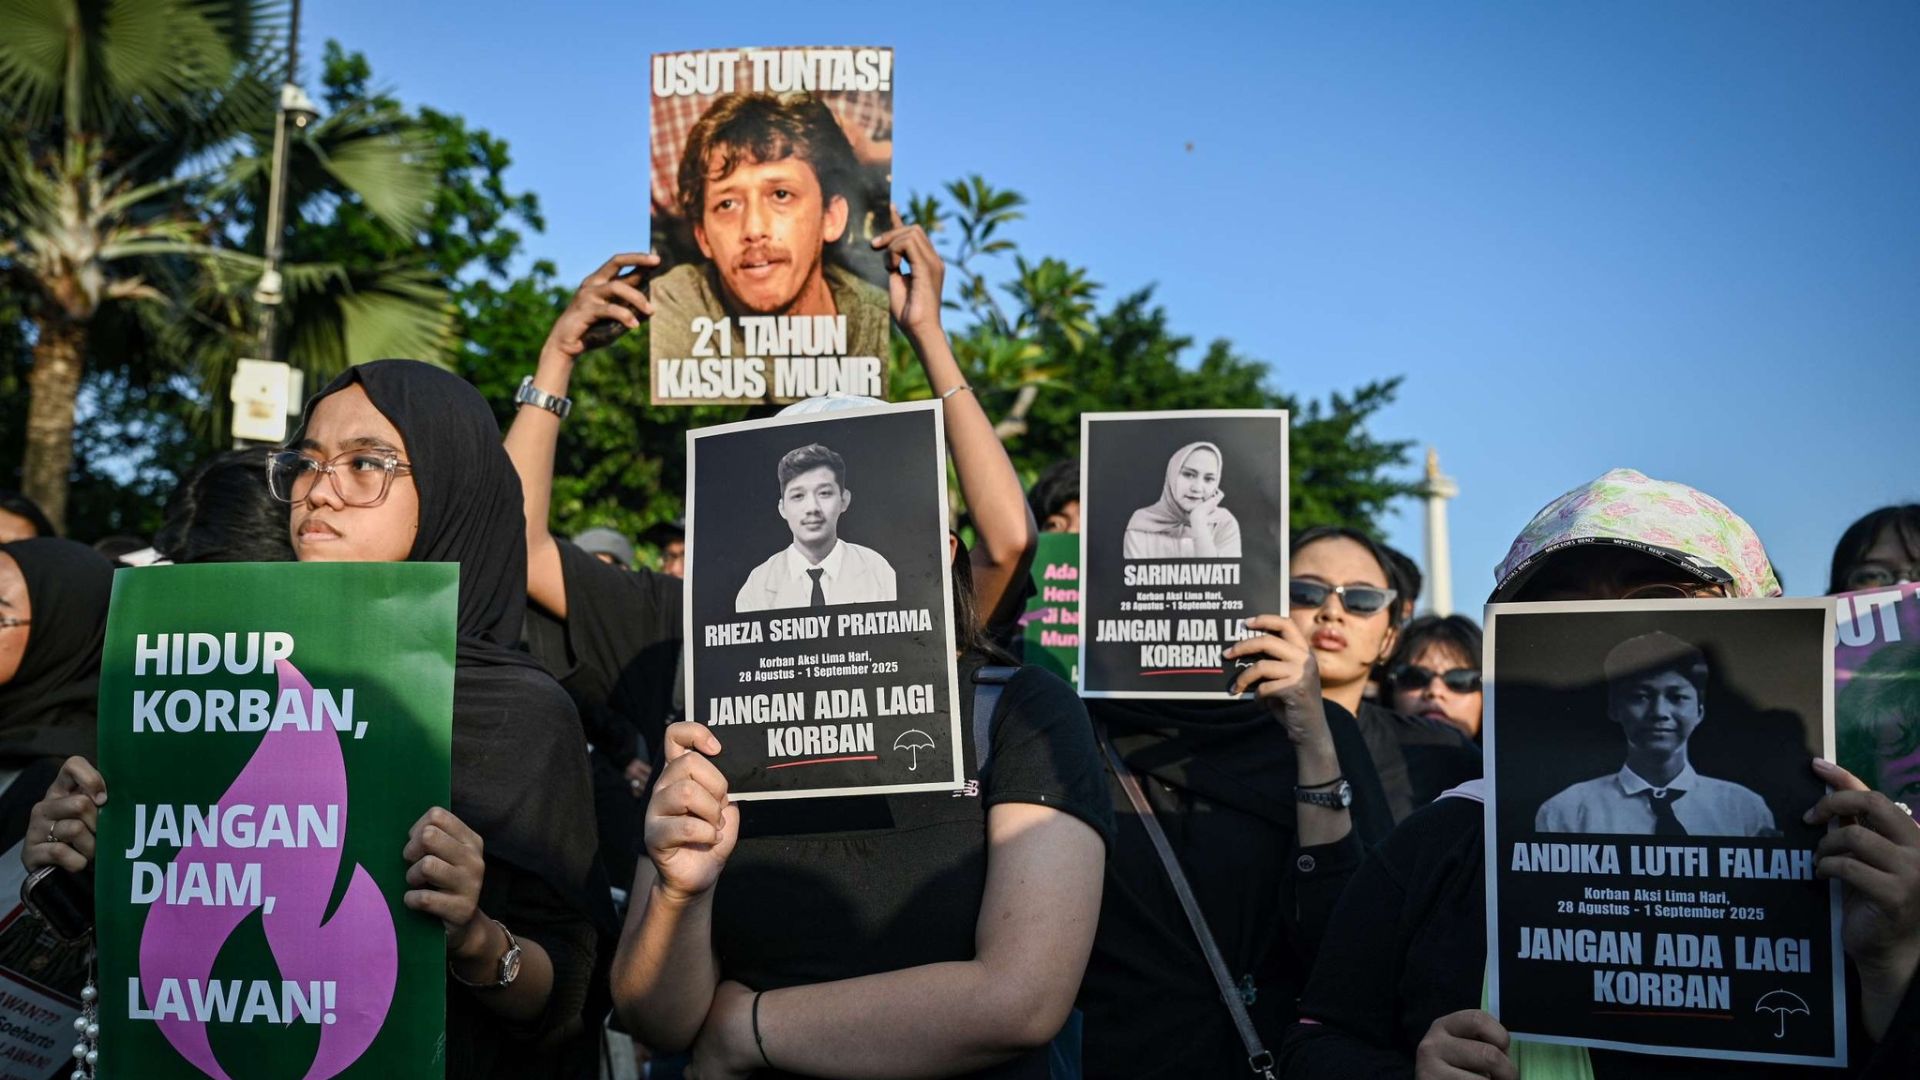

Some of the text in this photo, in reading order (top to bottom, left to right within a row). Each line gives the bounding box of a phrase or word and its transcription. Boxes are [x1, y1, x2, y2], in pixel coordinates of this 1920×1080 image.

[652, 50, 891, 97] USUT TUNTAS!
[691, 315, 847, 356] 21 TAHUN
[658, 357, 882, 398] KASUS MUNIR
[1043, 563, 1078, 580] Ada
[1124, 564, 1240, 586] SARINAWATI
[1121, 602, 1131, 611] 28
[1132, 602, 1164, 611] Agustus
[1172, 602, 1176, 610] 1
[1178, 601, 1220, 611] September
[1222, 601, 1243, 610] 2025
[1137, 591, 1223, 601] Korban Aksi Lima Hari,
[705, 609, 932, 647] RHEZA SENDY PRATAMA
[1096, 619, 1267, 642] JANGAN ADA LA
[1835, 590, 1903, 648] UT
[135, 632, 294, 675] HIDUP
[739, 671, 751, 682] 28
[755, 669, 794, 682] Agustus
[806, 668, 811, 678] 1
[814, 665, 868, 678] September
[872, 662, 898, 674] 2025
[759, 651, 872, 668] Korban Aksi Lima Hari,
[1141, 645, 1222, 668] KORBAN
[133, 688, 369, 739] KORBAN,
[708, 684, 934, 726] JANGAN ADA LAGI
[767, 723, 874, 757] KORBAN
[126, 804, 338, 859] JANGAN
[1511, 842, 1813, 880] ANDIKA LUTFI FALAH
[131, 861, 276, 914] DIAM,
[1585, 887, 1730, 905] Korban Aksi Lima Hari,
[1557, 901, 1574, 913] 28
[1578, 902, 1630, 916] Agustus
[1646, 904, 1651, 916] 1
[1655, 905, 1726, 919] September
[1730, 907, 1765, 921] 2025
[1518, 927, 1810, 973] JANGAN ADA LAGI
[128, 977, 337, 1024] LAWAN!
[1593, 970, 1730, 1010] KORBAN
